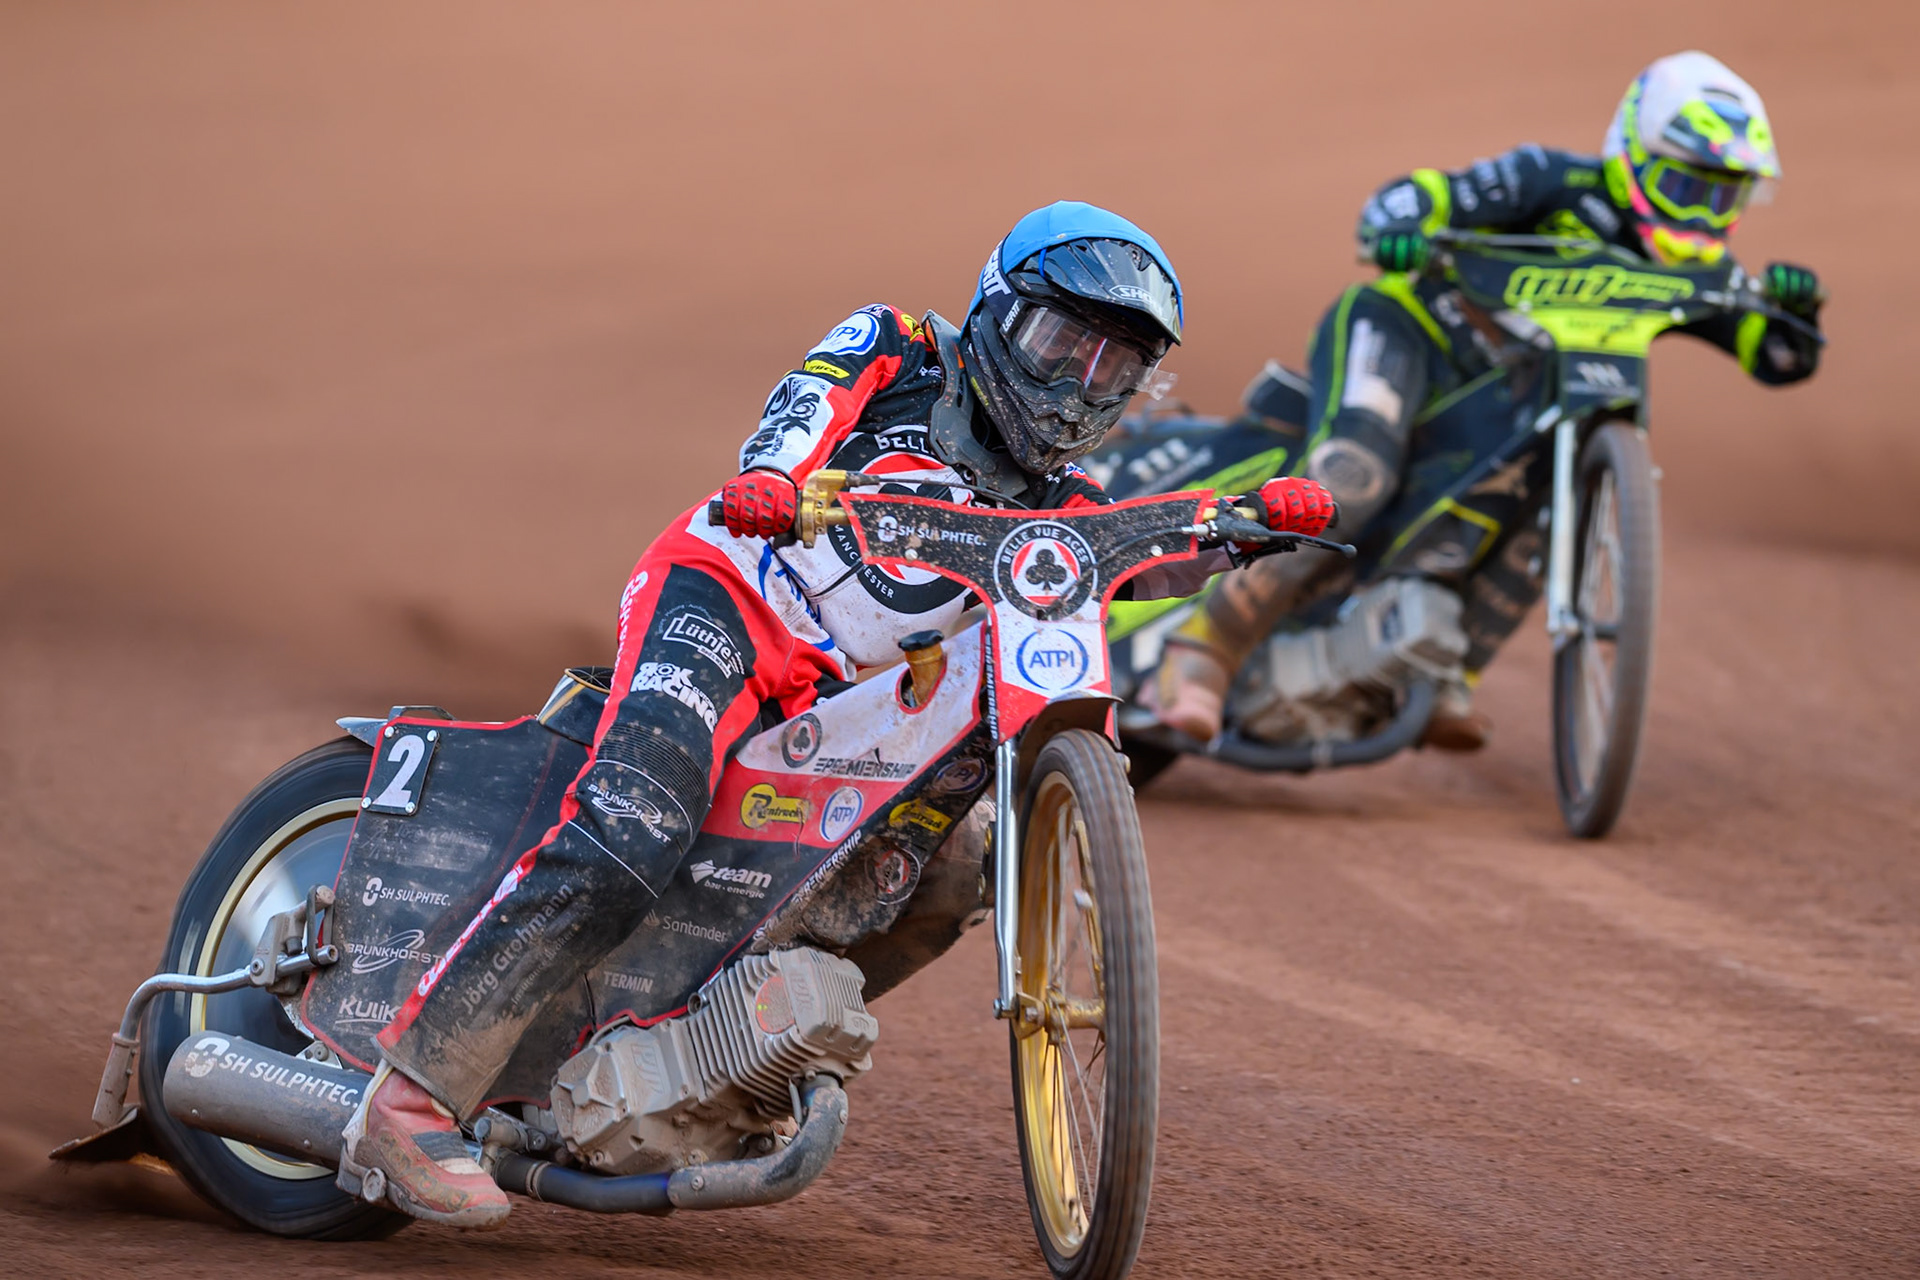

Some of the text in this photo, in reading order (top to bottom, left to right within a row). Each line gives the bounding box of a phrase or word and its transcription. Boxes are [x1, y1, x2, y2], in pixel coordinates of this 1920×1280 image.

[873, 434, 936, 456] BELL
[898, 524, 915, 537] SH
[1000, 525, 1090, 564] BELLE VUE ACES
[673, 616, 732, 660] Lüthje
[1028, 650, 1076, 668] ATPI
[371, 733, 426, 809] 2
[713, 866, 773, 889] team
[379, 886, 396, 899] SH
[726, 885, 766, 900] energie
[662, 915, 728, 942] Santander
[461, 970, 500, 1015] Jörg
[493, 882, 575, 972] Grohmann
[603, 970, 654, 994] TERMIN
[219, 1052, 253, 1075] SH
